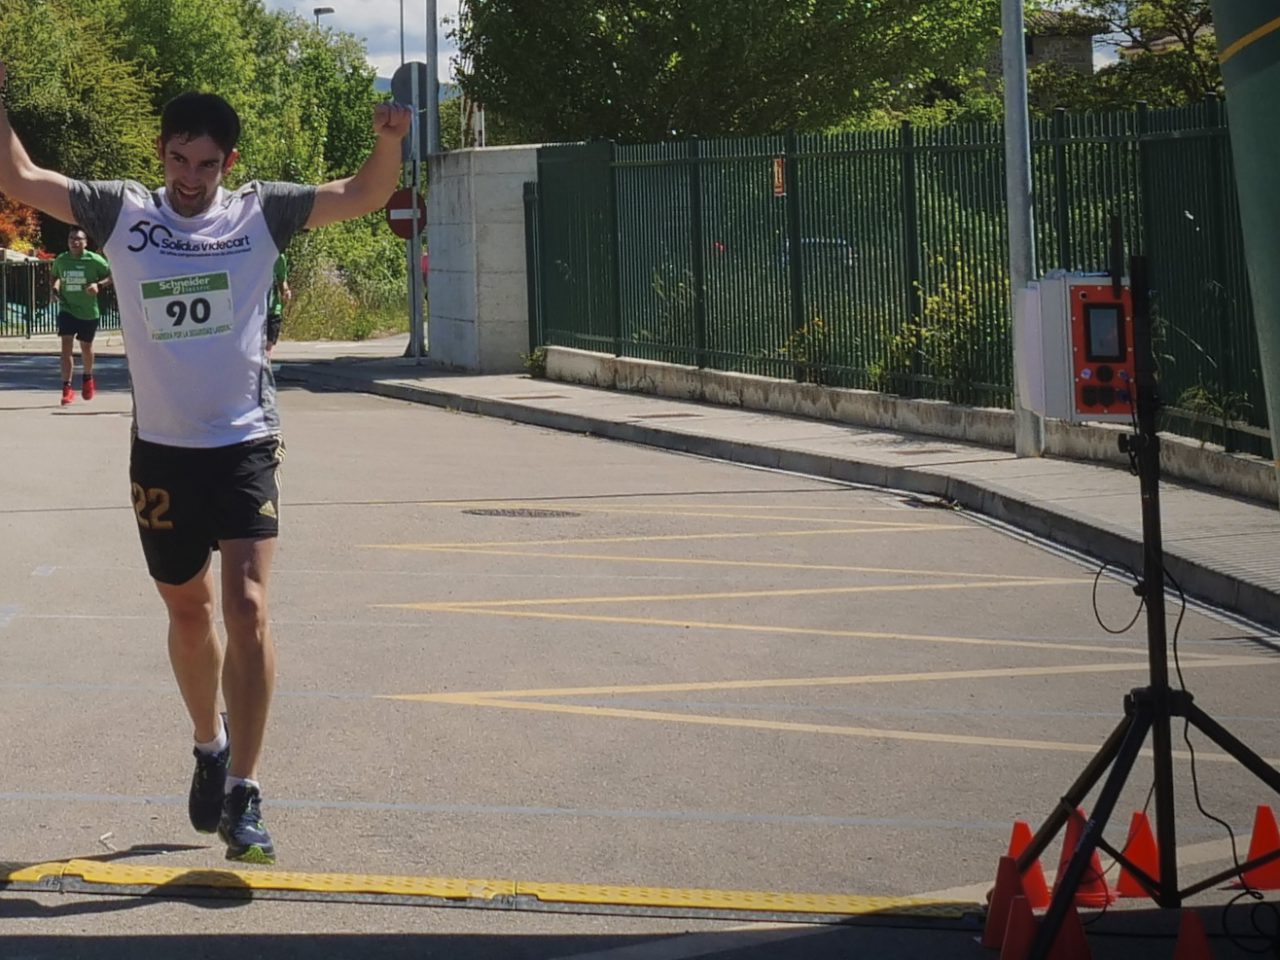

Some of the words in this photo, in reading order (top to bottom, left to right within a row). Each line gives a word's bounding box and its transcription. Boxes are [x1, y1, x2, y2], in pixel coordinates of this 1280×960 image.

[159, 276, 210, 294] Schneider
[166, 297, 211, 327] 90
[131, 482, 174, 529] 22
